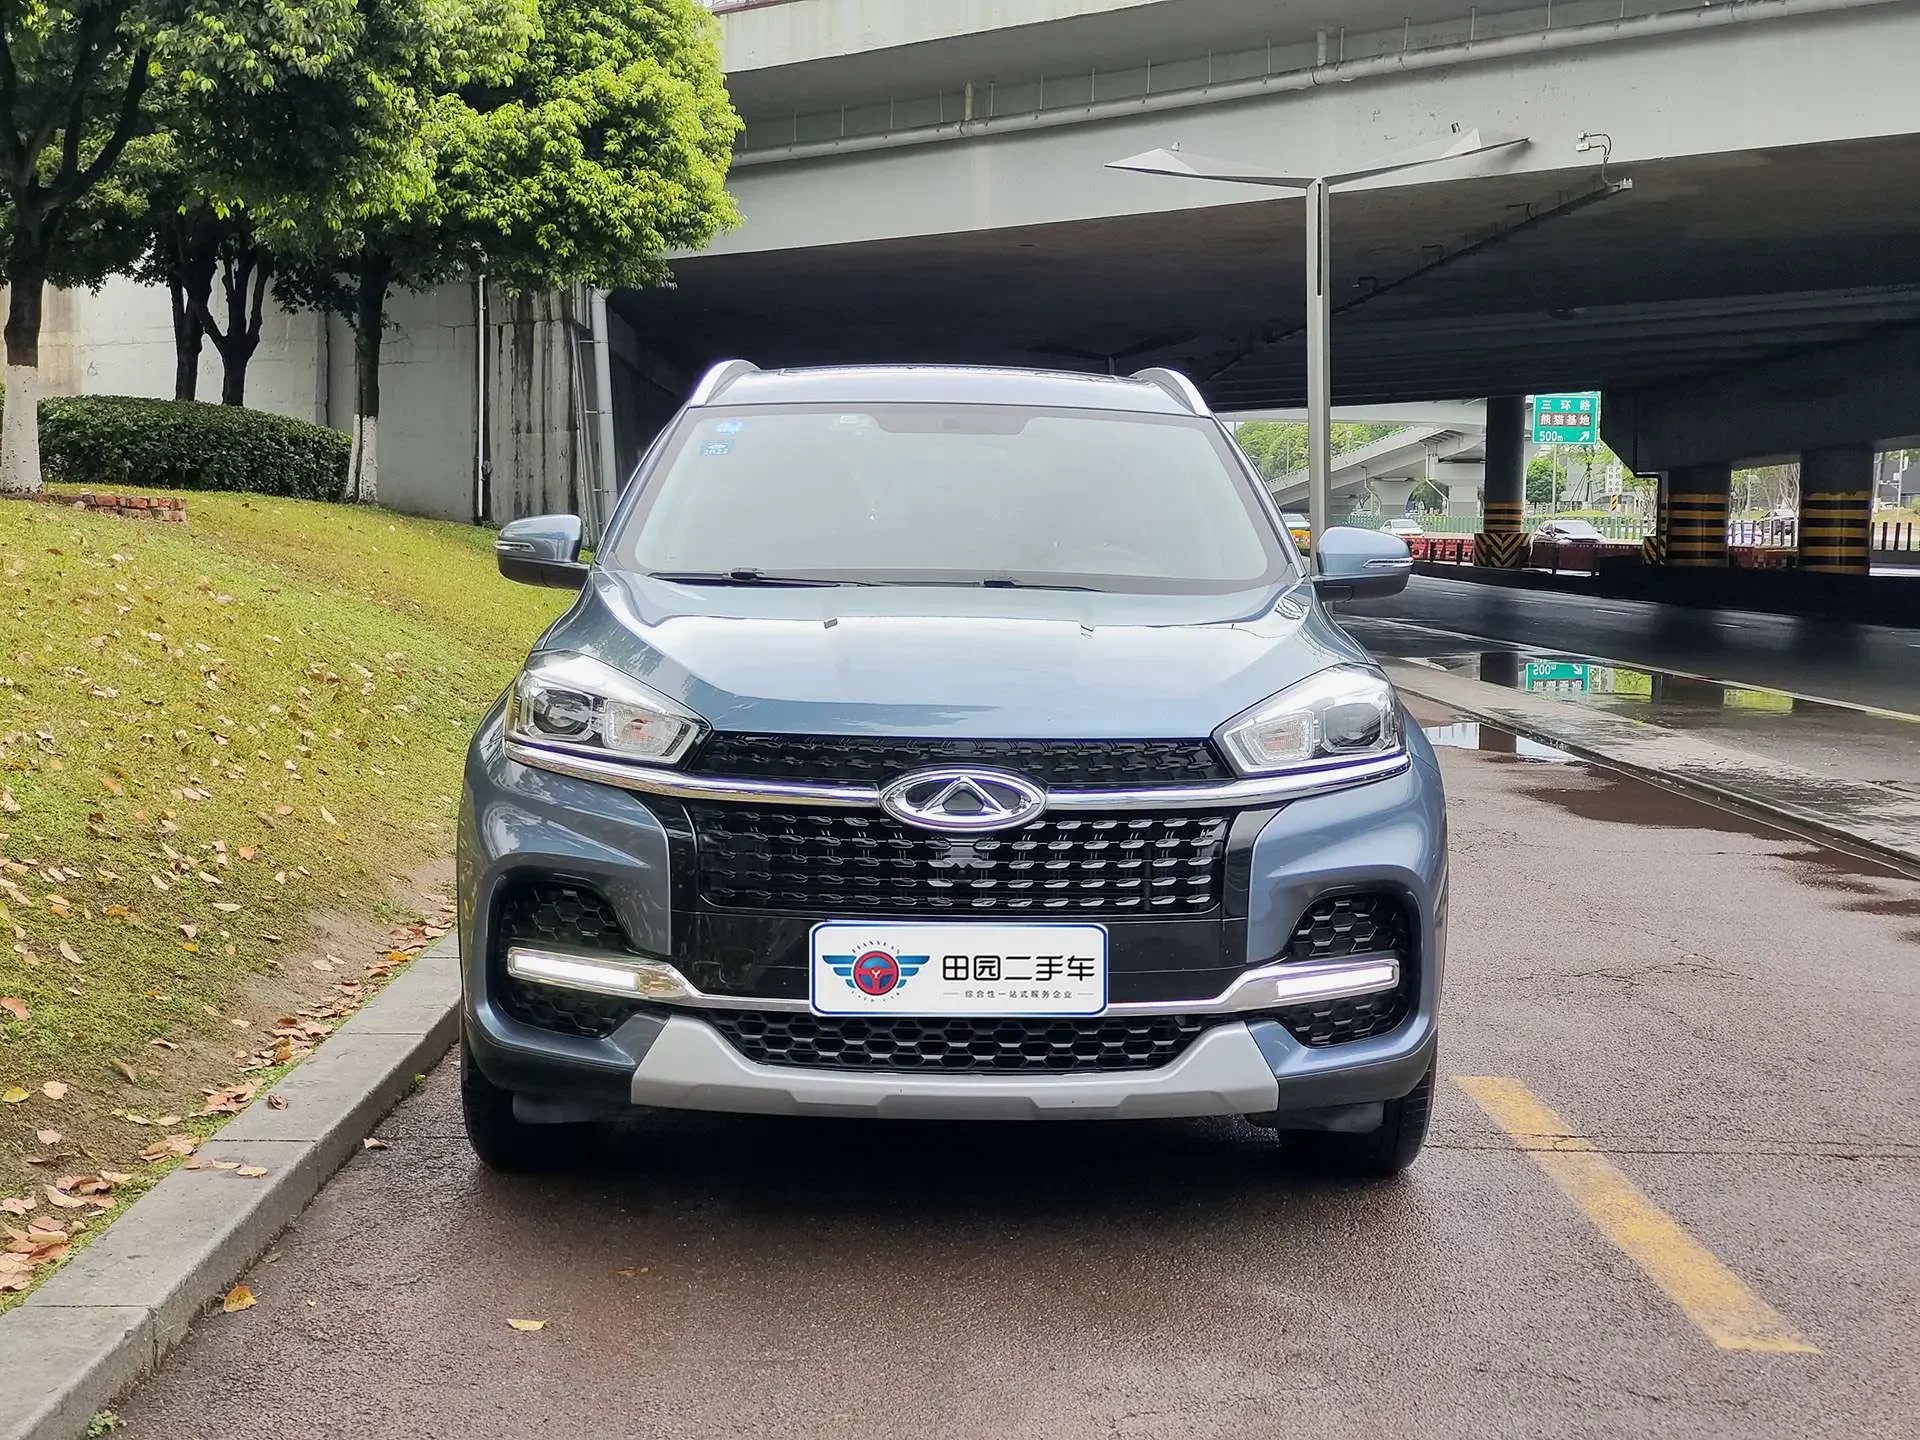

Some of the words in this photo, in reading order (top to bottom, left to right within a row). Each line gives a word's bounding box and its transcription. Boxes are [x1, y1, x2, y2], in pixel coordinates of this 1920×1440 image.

[1541, 399, 1591, 411] 三环路
[1540, 413, 1591, 426] 熊猫基地
[1539, 430, 1564, 442] 500m
[942, 955, 1096, 982] 田园二手车
[964, 989, 1073, 999] 综合性一站式服务企业
